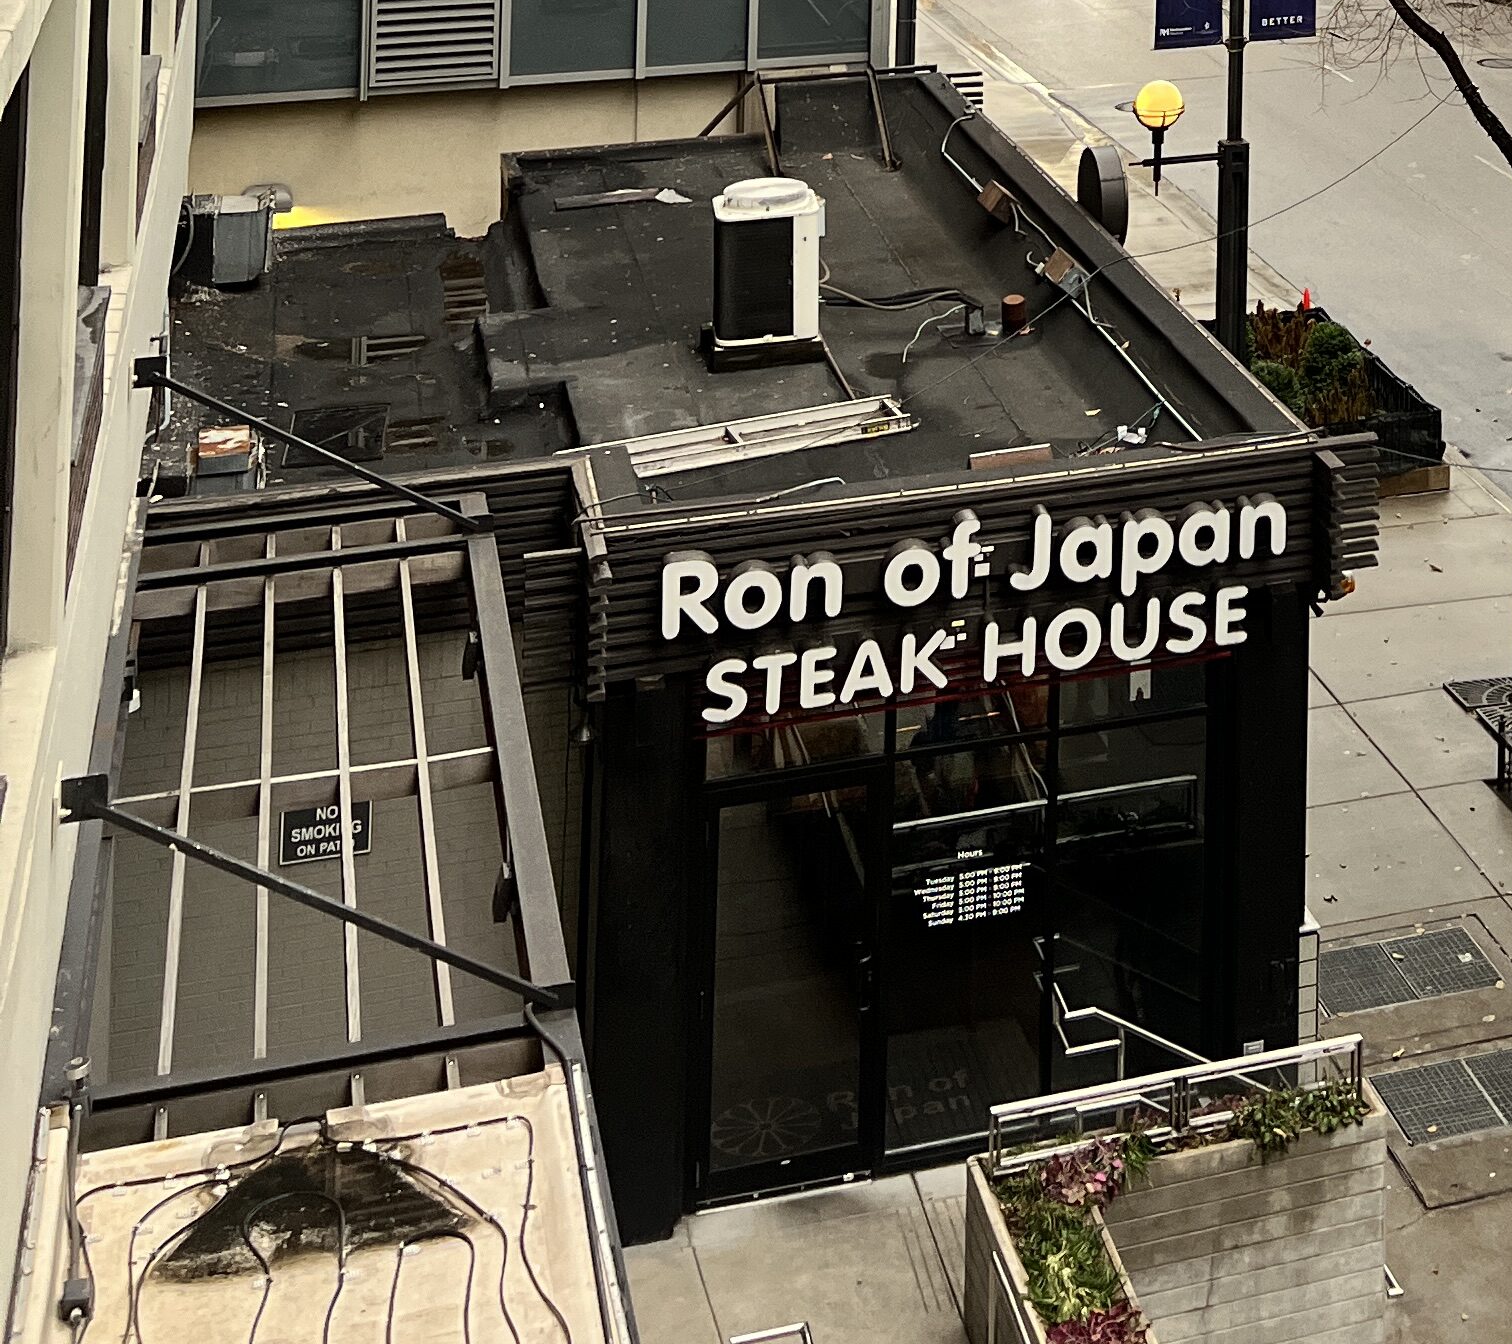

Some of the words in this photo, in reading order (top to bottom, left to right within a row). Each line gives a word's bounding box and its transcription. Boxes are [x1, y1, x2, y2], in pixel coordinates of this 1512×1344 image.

[1261, 16, 1303, 27] BETTER
[661, 559, 843, 640] Ron
[884, 518, 981, 607] of
[1010, 502, 1287, 597] Japan
[701, 629, 948, 723] STEAK
[983, 585, 1249, 682] HOUSE
[316, 805, 339, 821] NO
[291, 819, 362, 843] SMOKIG
[296, 844, 316, 857] ON
[319, 839, 355, 854] PAT
[957, 849, 983, 859] Hours
[914, 884, 954, 896] Wednesday
[1011, 872, 1022, 880] PM
[926, 876, 954, 885] Tuesday
[976, 869, 988, 877] PM
[923, 910, 954, 919] Saturday
[932, 901, 954, 910] Friday
[928, 918, 954, 927] Sunday
[1010, 905, 1021, 913] PM
[828, 1085, 912, 1111] Rn
[841, 1095, 970, 1131] Jpan
